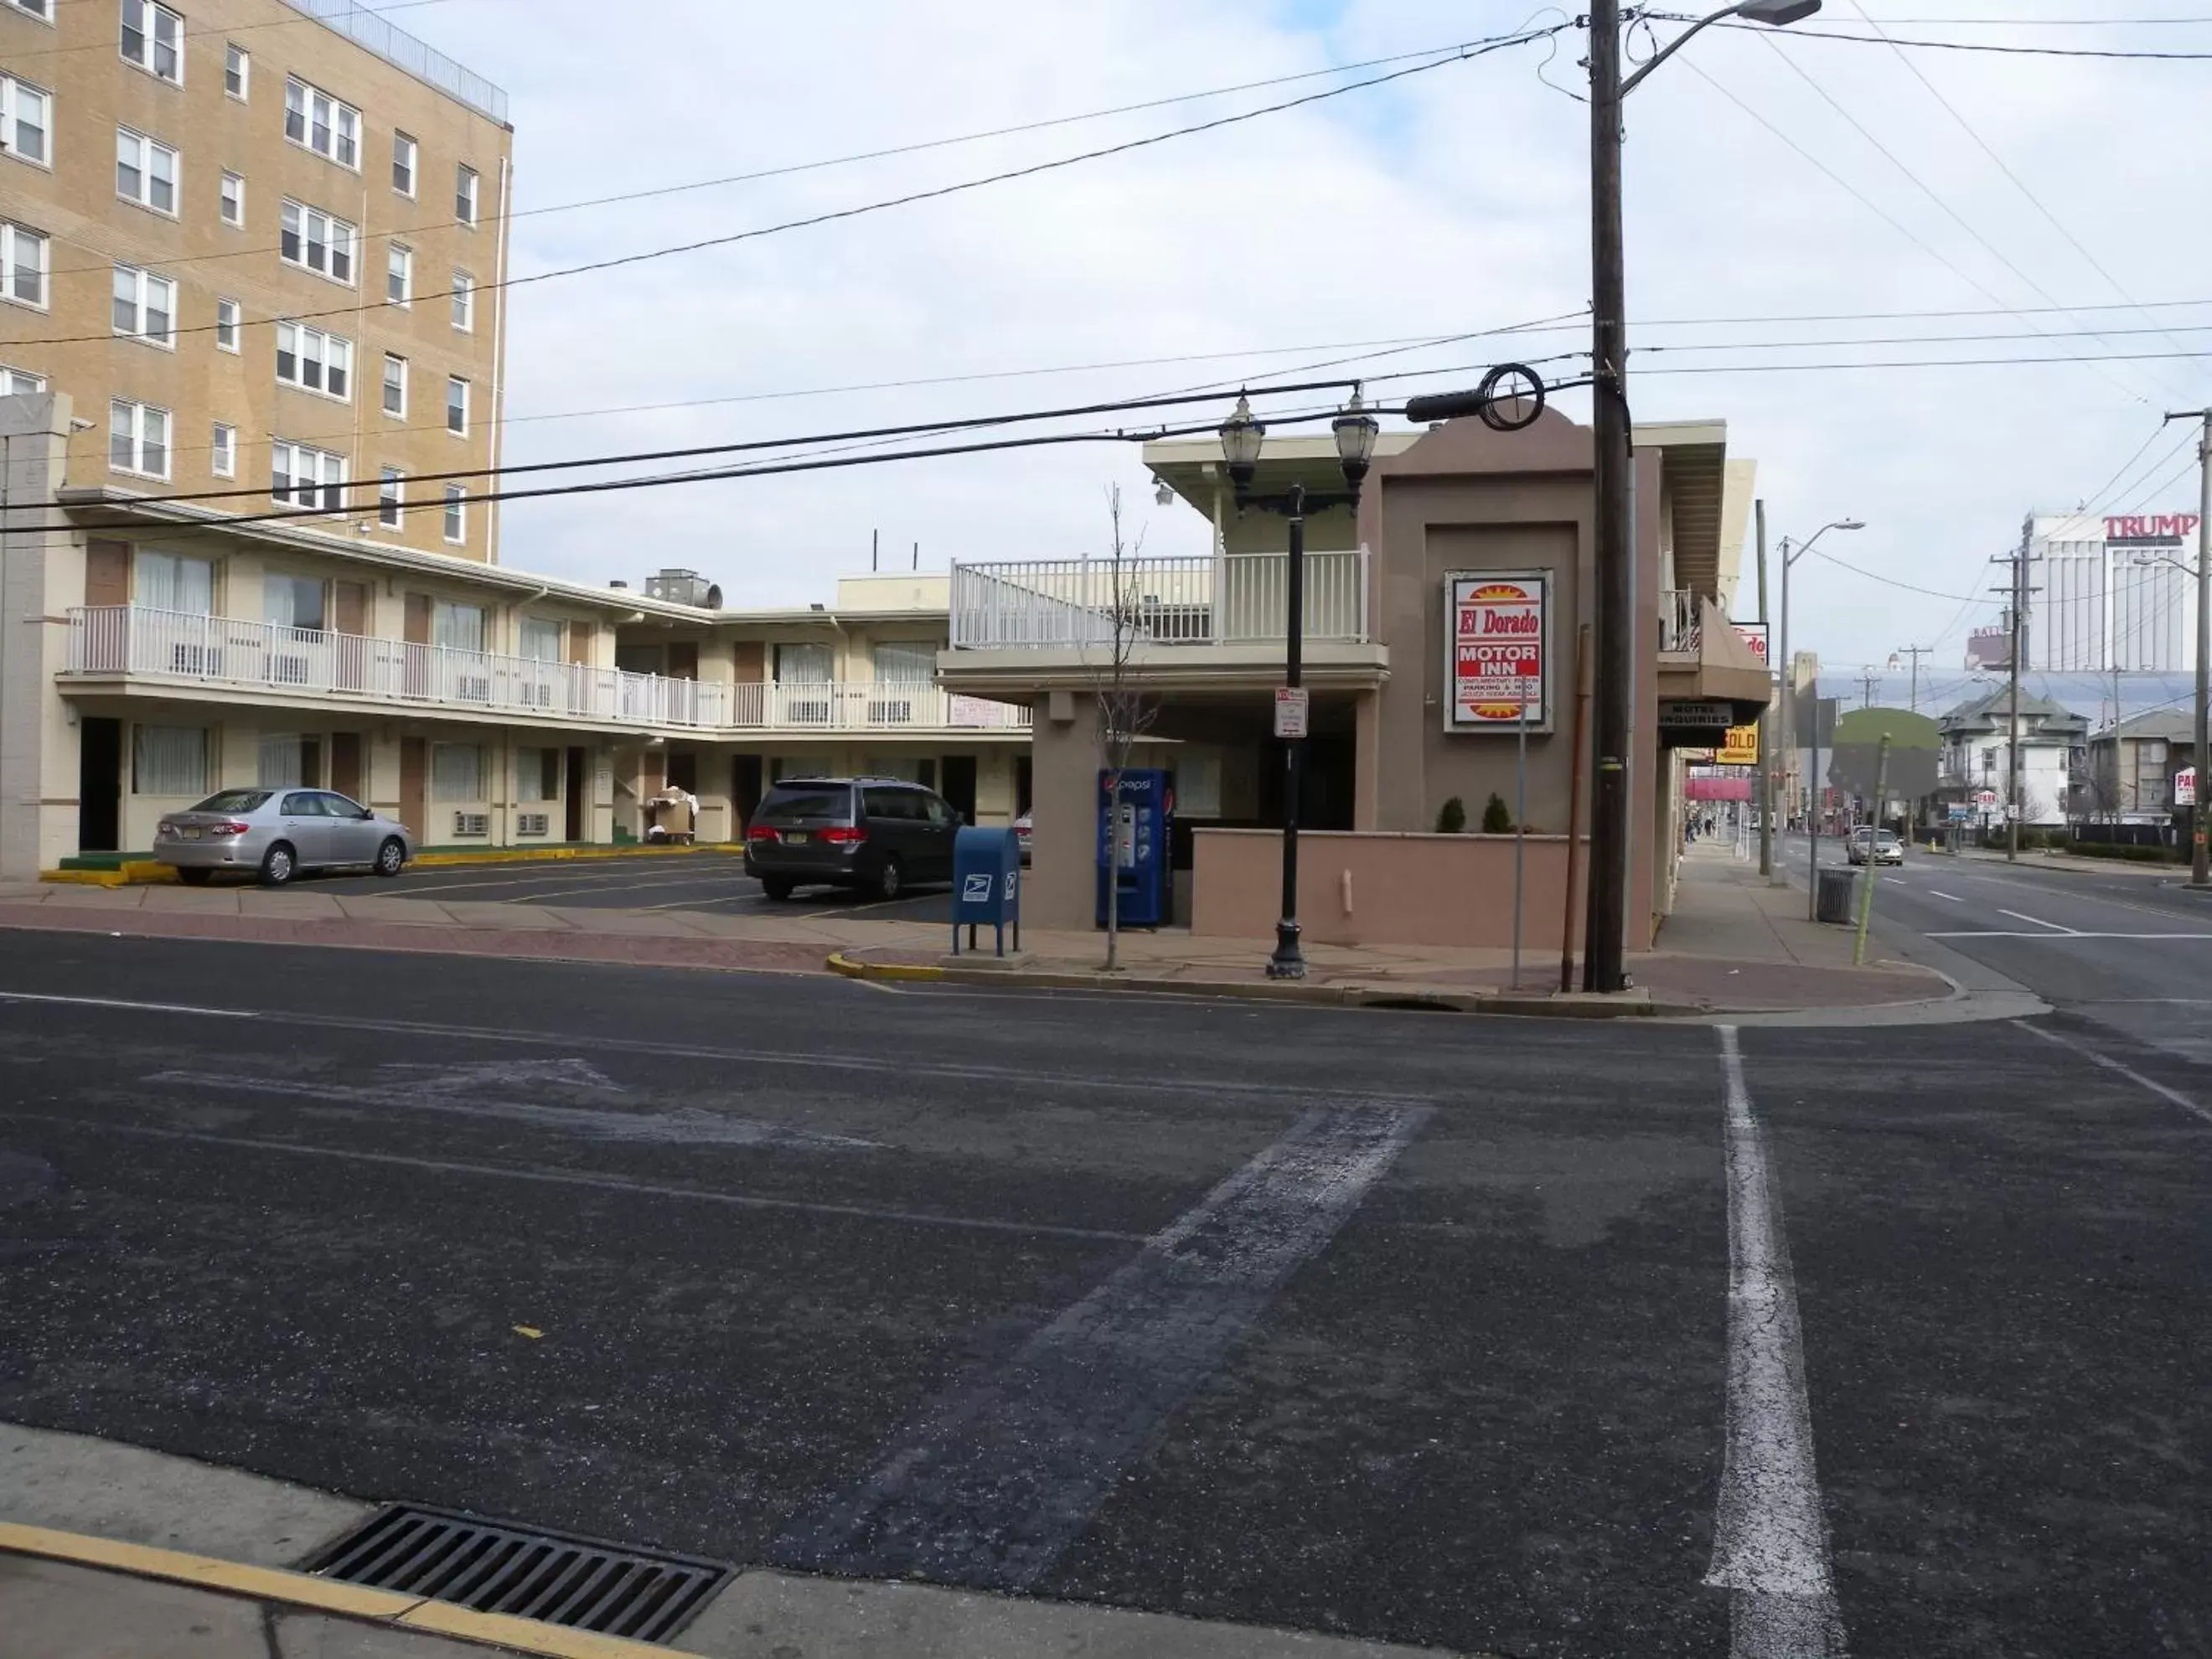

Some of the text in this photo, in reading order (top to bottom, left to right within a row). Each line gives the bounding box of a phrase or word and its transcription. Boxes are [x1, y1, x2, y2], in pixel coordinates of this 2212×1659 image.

[2102, 514, 2199, 536] TRUMP
[1459, 608, 1538, 633] El Dorado
[1460, 646, 1536, 661] MOTOR
[1481, 661, 1517, 675] INN
[1119, 780, 1150, 791] pepsi
